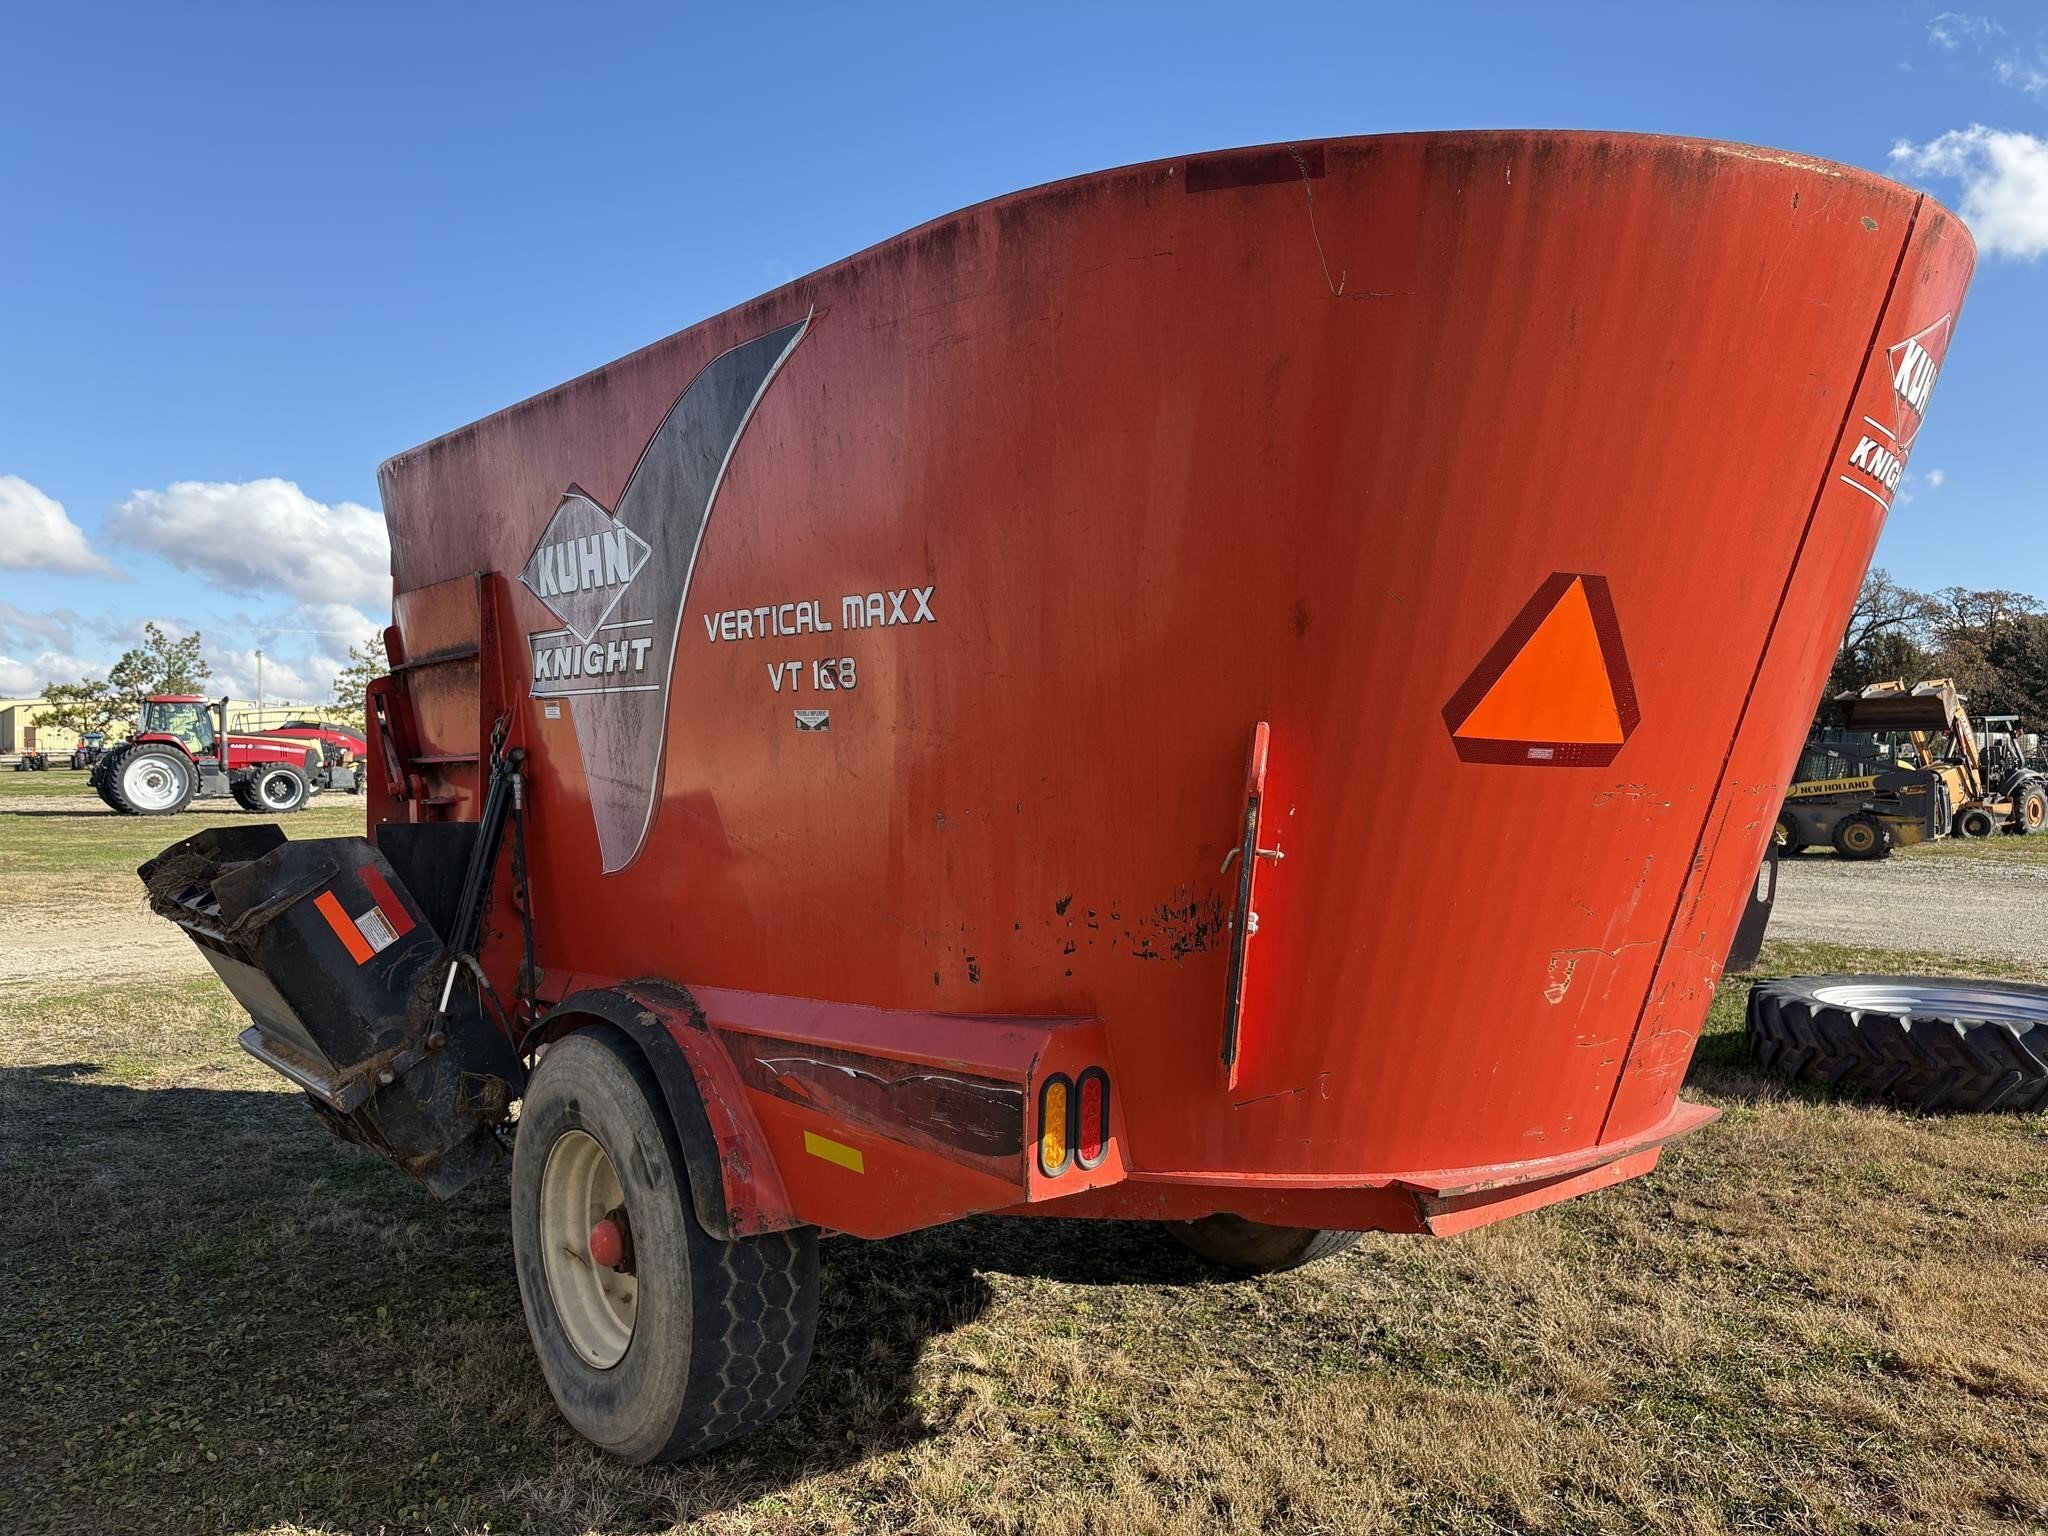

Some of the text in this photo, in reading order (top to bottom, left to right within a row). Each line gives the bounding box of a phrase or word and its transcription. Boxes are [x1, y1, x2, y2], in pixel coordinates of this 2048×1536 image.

[1894, 338, 1938, 418] KUH
[537, 526, 631, 599] KUHN
[703, 586, 937, 643] VERTICAL MAXX
[535, 637, 653, 682] KNIGHT
[766, 659, 803, 692] VT
[1800, 780, 1869, 794] NEW HOLLAND
